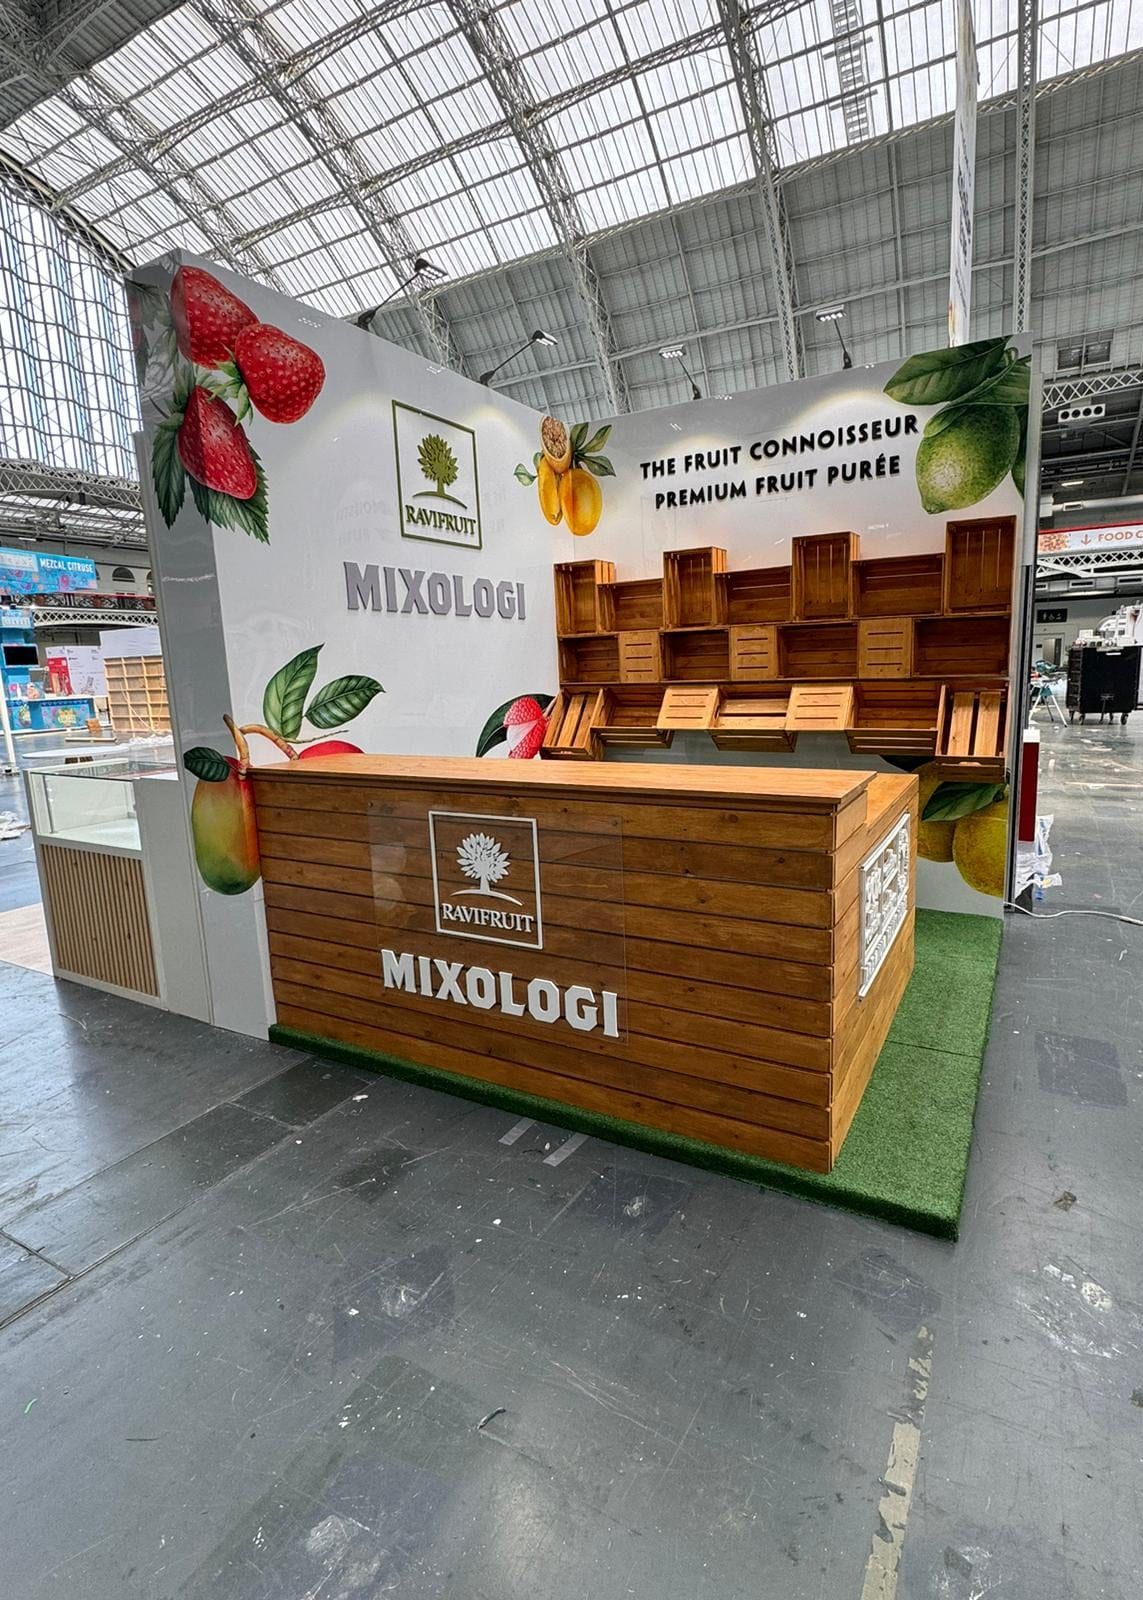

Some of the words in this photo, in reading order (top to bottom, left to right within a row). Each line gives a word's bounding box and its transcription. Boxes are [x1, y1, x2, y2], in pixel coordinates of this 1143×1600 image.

[640, 458, 676, 480] THE
[684, 446, 742, 473] FRUIT
[749, 414, 919, 460] CONNOISSEUR
[655, 480, 747, 510] PREMIUM
[755, 468, 818, 495] FRUIT
[828, 453, 901, 485] PURÉE
[405, 505, 477, 535] RAVIFRUIT
[1098, 531, 1133, 541] FOOD
[39, 558, 66, 570] MEZCAL
[343, 561, 526, 620] MIXOLOGI
[441, 903, 534, 933] RAVIFRUIT
[381, 948, 619, 1038] MIXOLOGI
